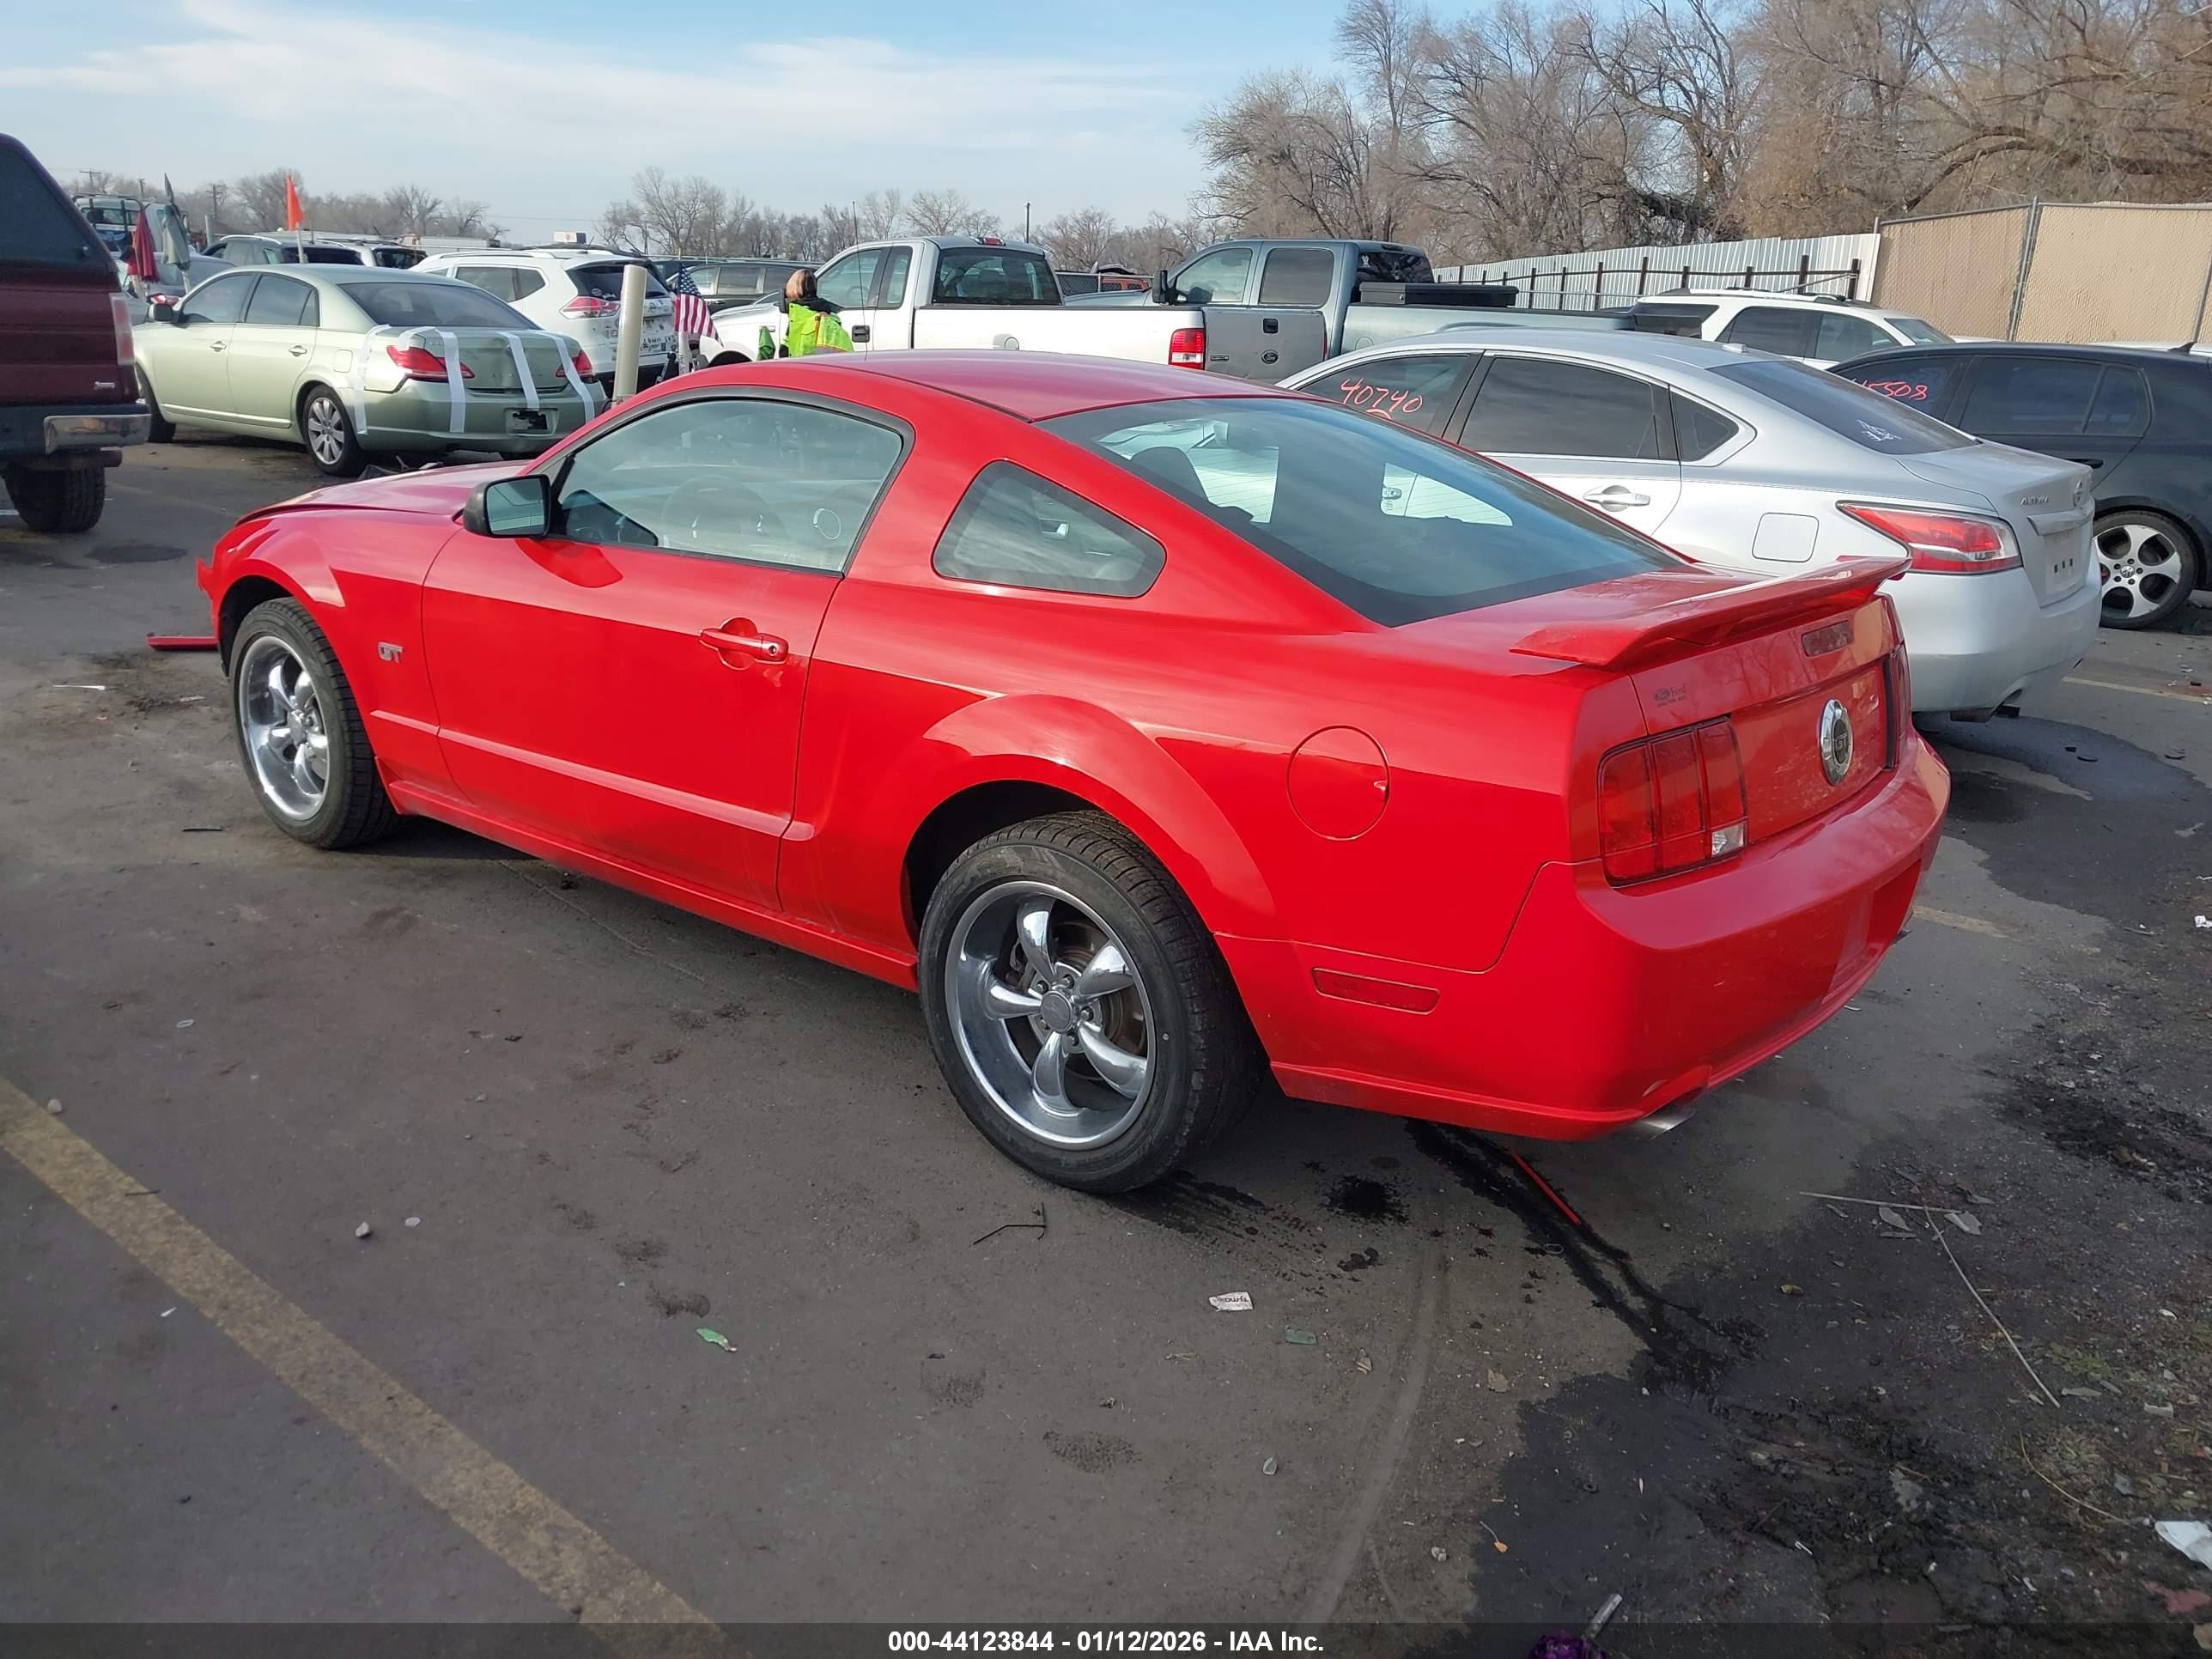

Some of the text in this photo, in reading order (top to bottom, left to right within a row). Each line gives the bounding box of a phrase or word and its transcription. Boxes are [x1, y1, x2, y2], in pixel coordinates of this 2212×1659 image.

[1340, 378, 1423, 413] 40740
[1851, 378, 1929, 401] 508
[378, 641, 404, 664] GT
[1835, 732, 1848, 751] GT
